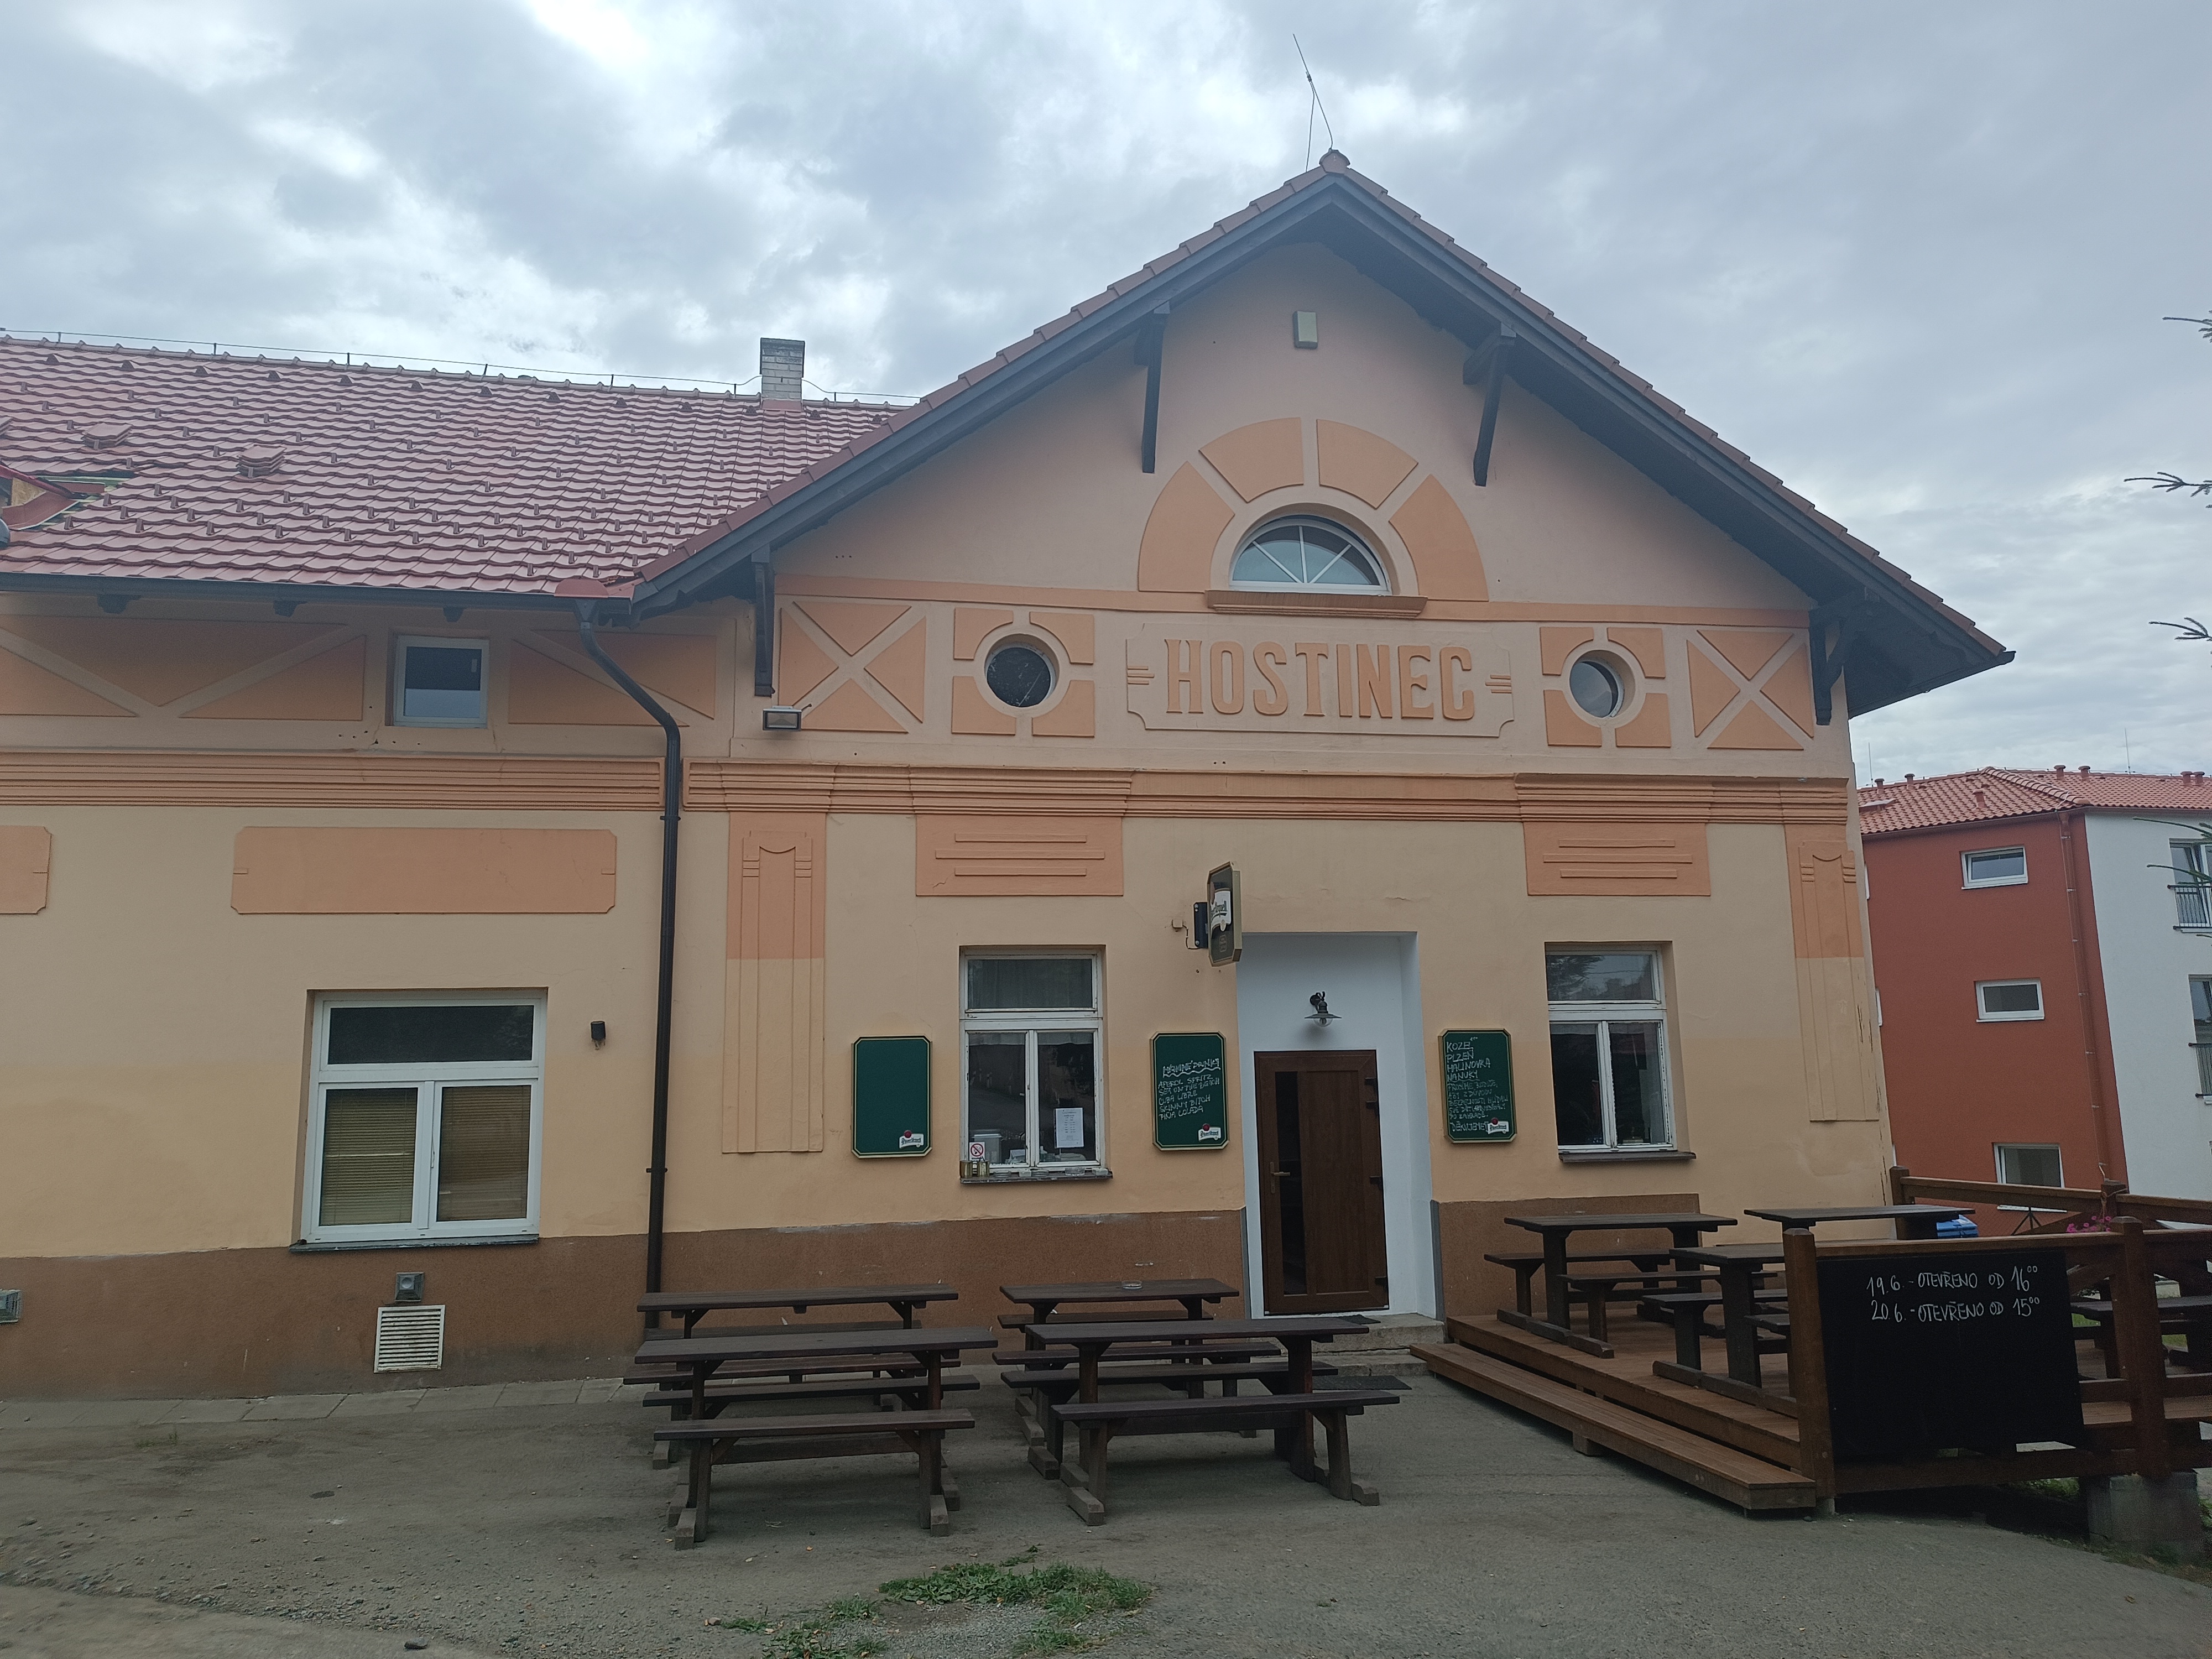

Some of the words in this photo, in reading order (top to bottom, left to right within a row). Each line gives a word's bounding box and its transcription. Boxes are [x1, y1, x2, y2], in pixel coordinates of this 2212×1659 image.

[1164, 639, 1475, 720] HOSTINEC
[1158, 1079, 1183, 1089] APEROL
[1187, 1074, 1213, 1083] SPRITZ
[1159, 1095, 1175, 1105] CUBA
[1178, 1090, 1198, 1100] LIBRE
[1160, 1101, 1188, 1112] SKINNY
[1190, 1094, 1211, 1106] BITCH
[1178, 1105, 1204, 1117] COLADA
[1918, 1271, 1978, 1289] OTEVŘENO
[1988, 1272, 2005, 1289] OD
[1918, 1301, 1984, 1322] OTEVŘENO
[1989, 1301, 2004, 1316] OD
